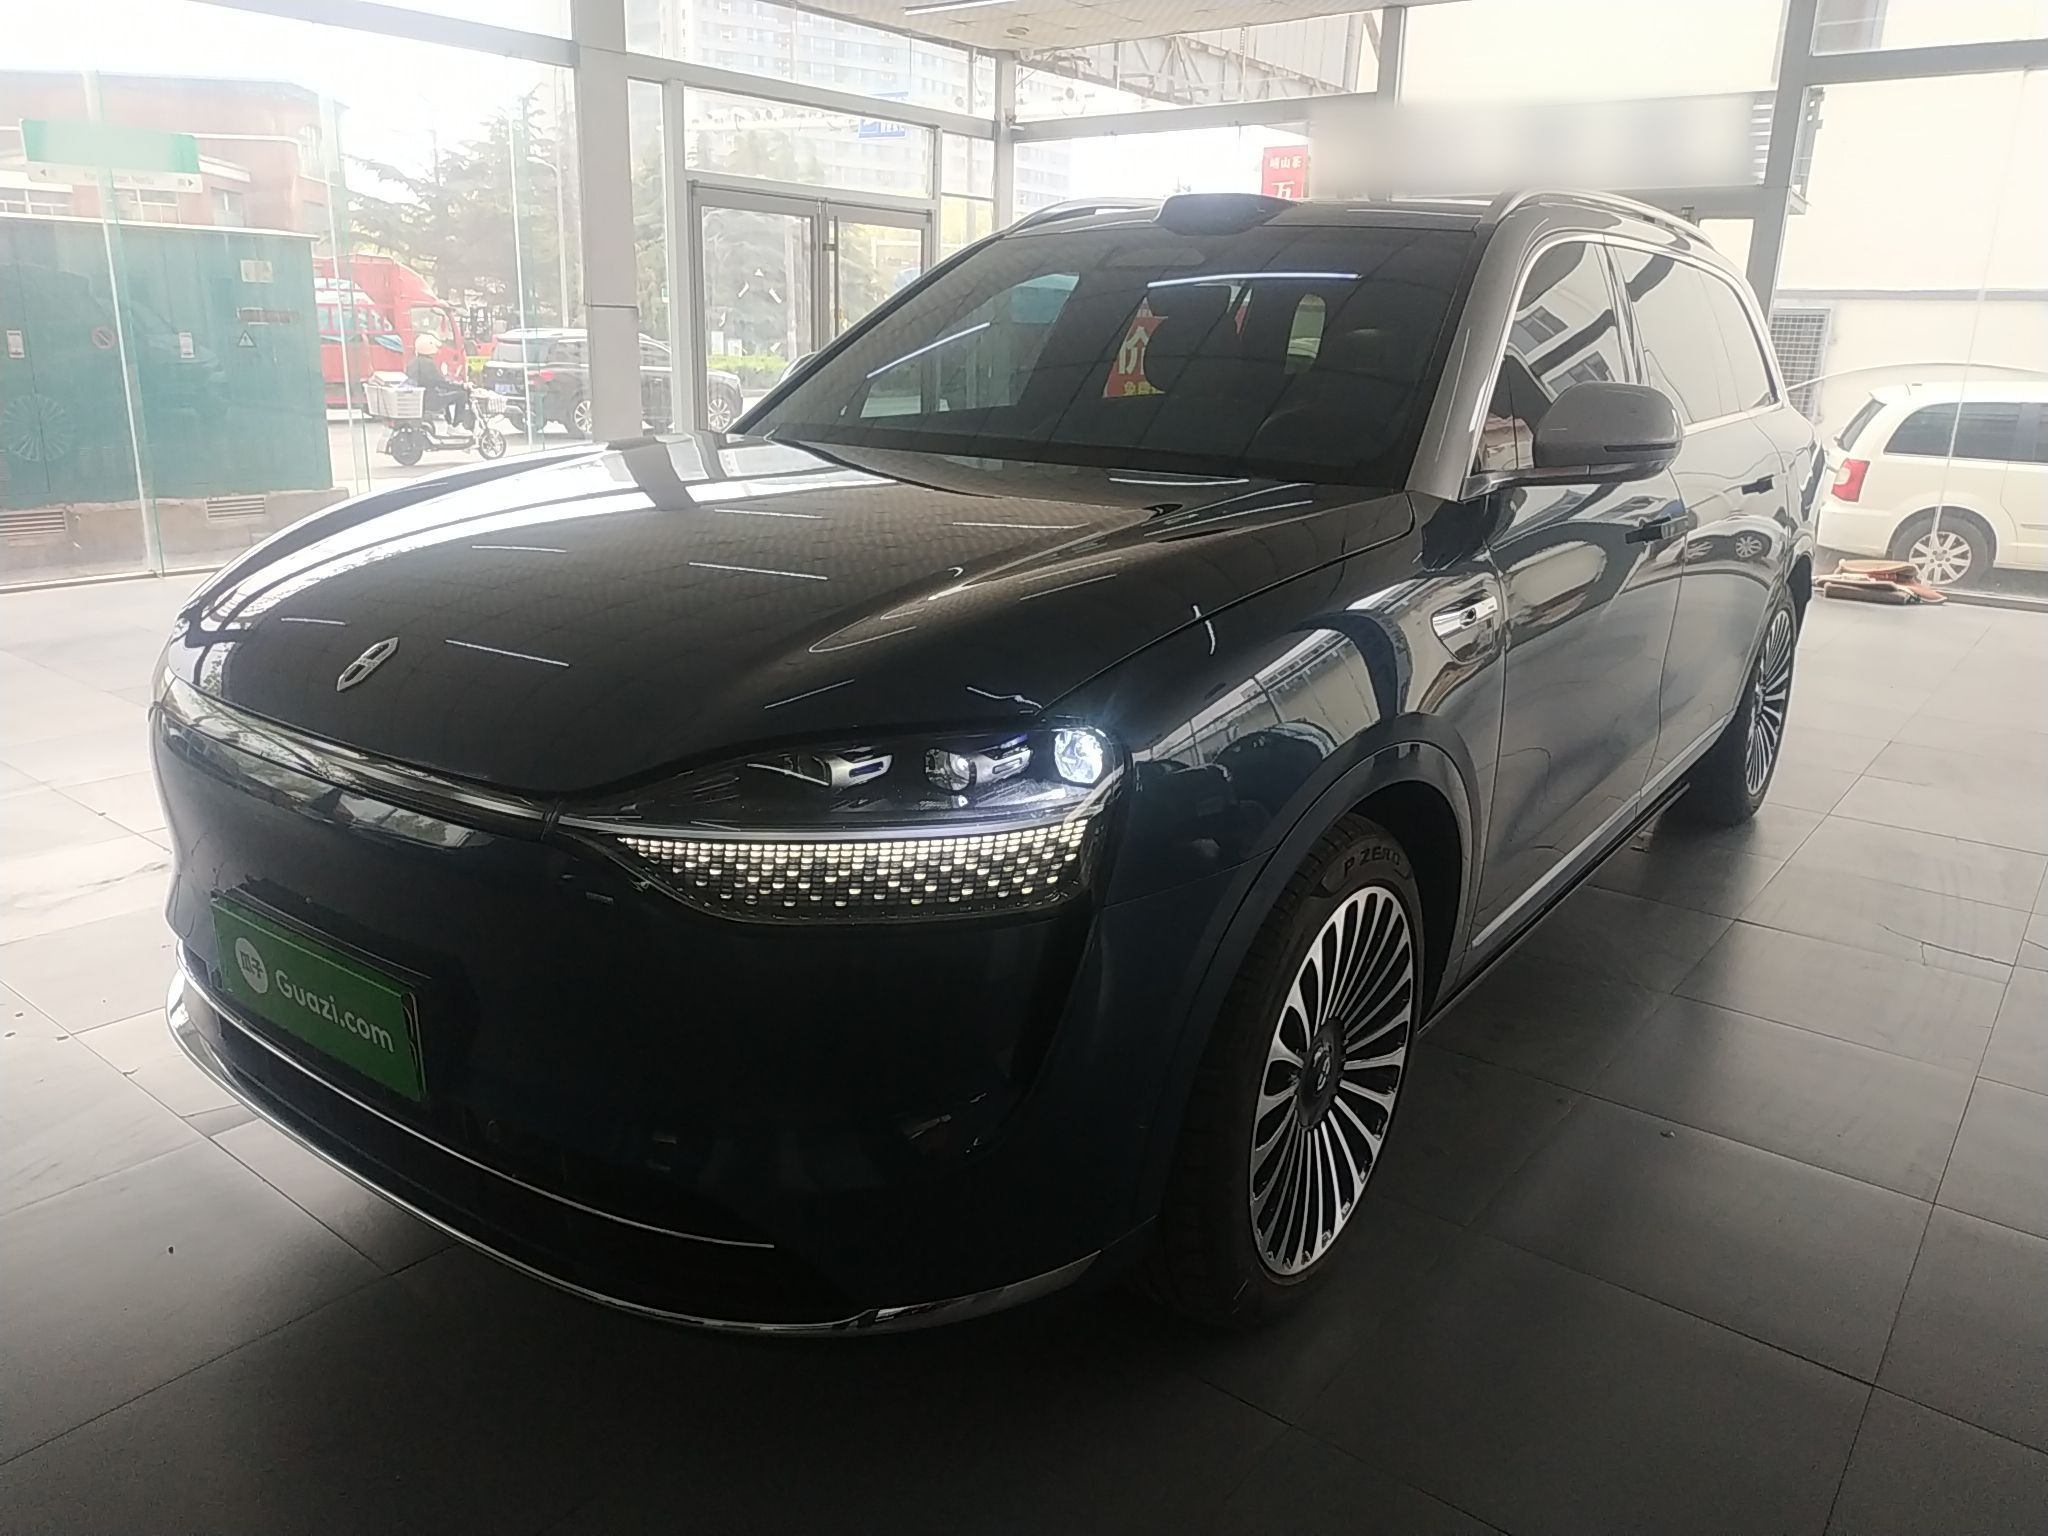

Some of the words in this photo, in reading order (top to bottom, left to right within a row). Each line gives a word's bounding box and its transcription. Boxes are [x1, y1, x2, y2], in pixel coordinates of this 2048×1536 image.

[1343, 857, 1355, 878] P
[1360, 846, 1400, 866] ZERO
[239, 950, 264, 980] 瓜子
[275, 969, 394, 1053] Guazi.com
